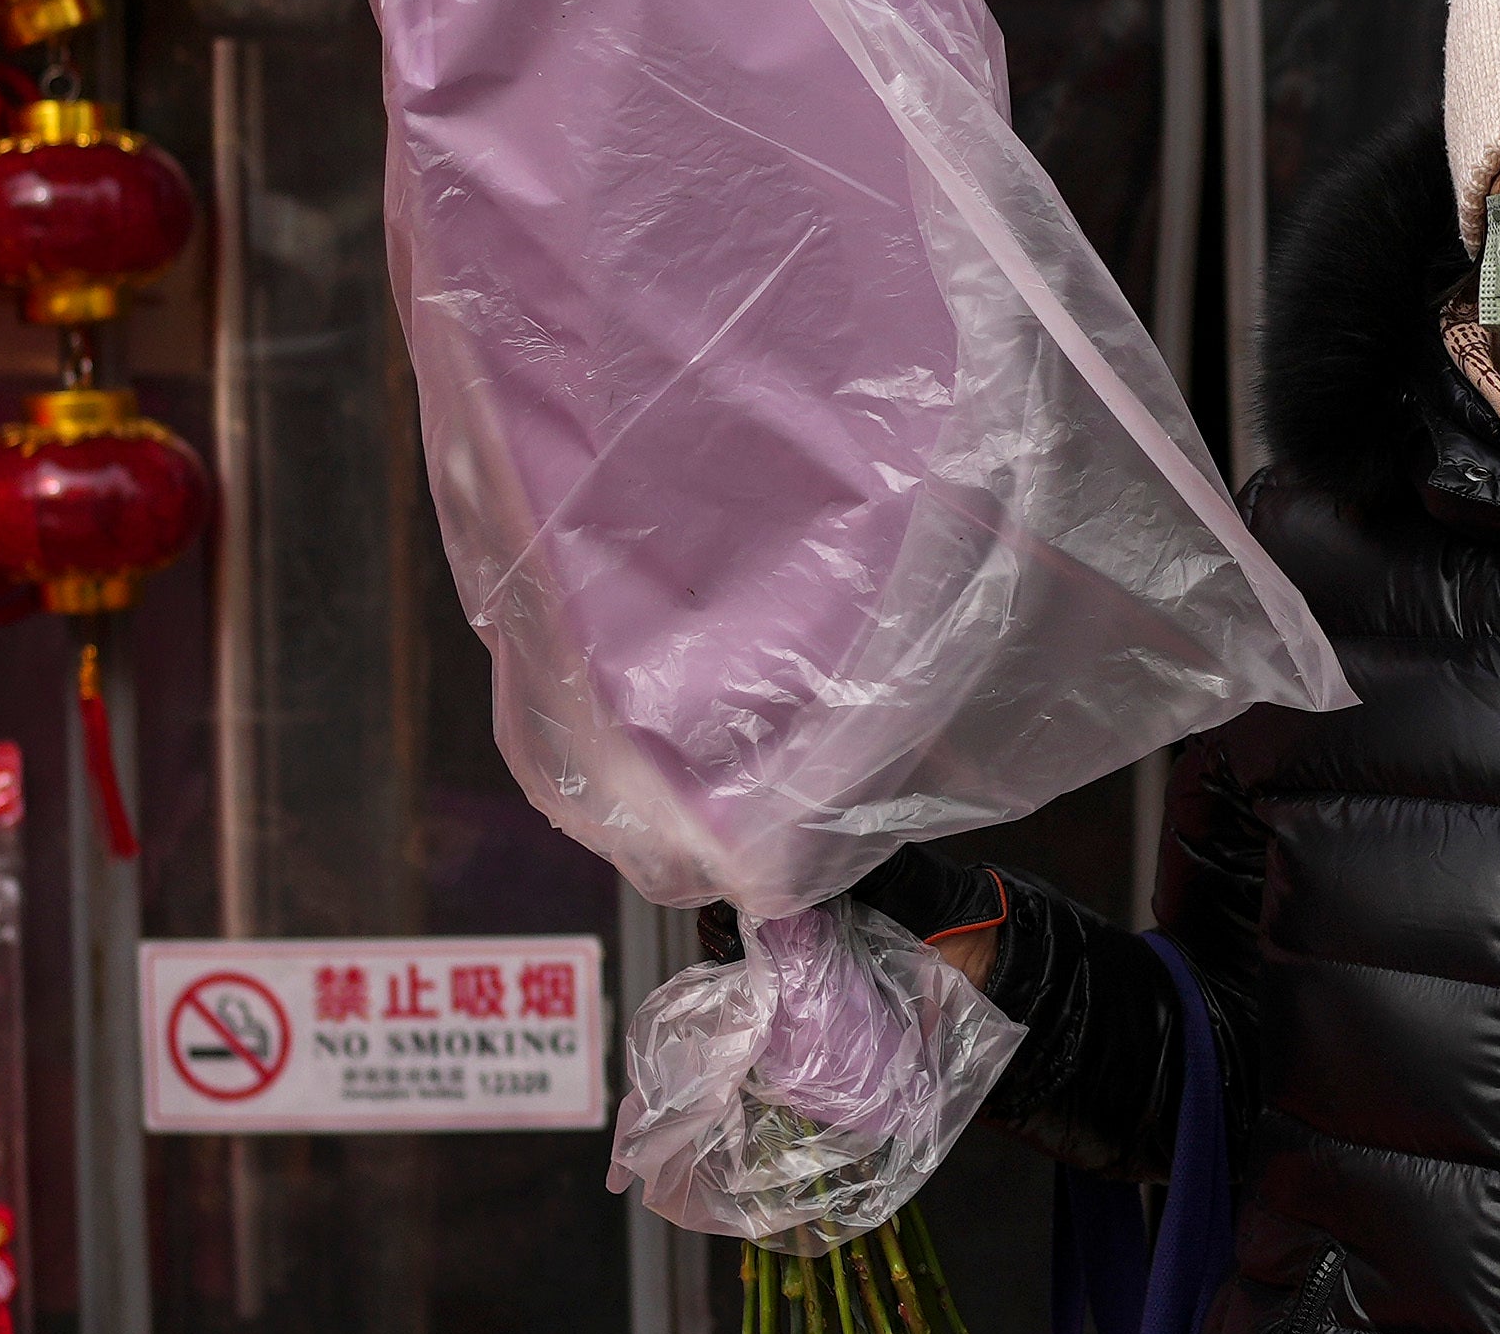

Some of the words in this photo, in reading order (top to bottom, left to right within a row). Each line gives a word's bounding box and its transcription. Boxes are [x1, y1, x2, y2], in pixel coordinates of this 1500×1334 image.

[314, 962, 577, 1023] 禁止吸烟
[313, 1030, 370, 1061] NO
[388, 1028, 577, 1060] SMOKING
